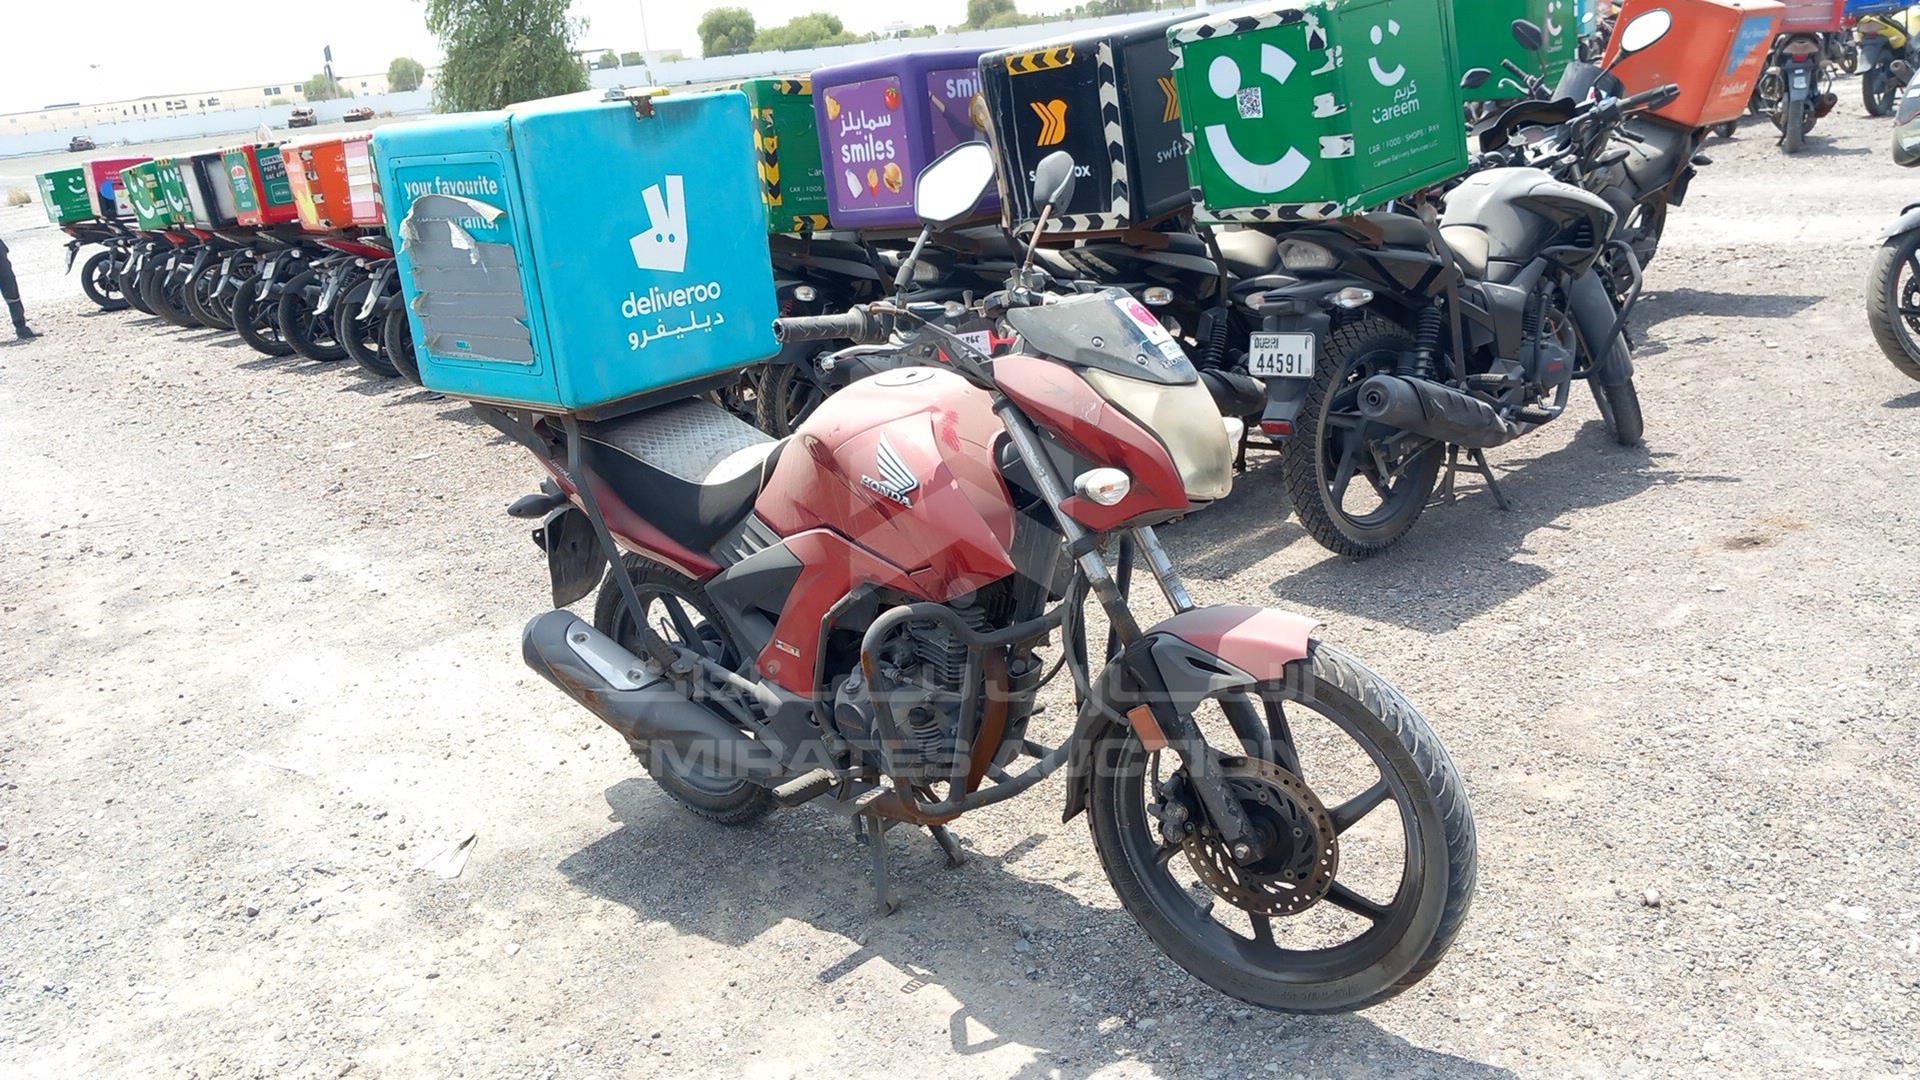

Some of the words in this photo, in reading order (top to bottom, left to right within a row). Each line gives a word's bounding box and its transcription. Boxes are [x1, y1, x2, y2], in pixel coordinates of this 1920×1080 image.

[1393, 80, 1417, 103] كريم
[840, 110, 891, 137] سمايلز
[1372, 98, 1420, 124] Careem
[841, 133, 895, 163] smiles
[404, 181, 432, 200] your
[434, 175, 499, 195] favourite
[621, 281, 721, 319] deliveroo
[627, 310, 725, 351] ديليفرو
[1256, 353, 1302, 375] 44591
[860, 474, 914, 509] HONDA
